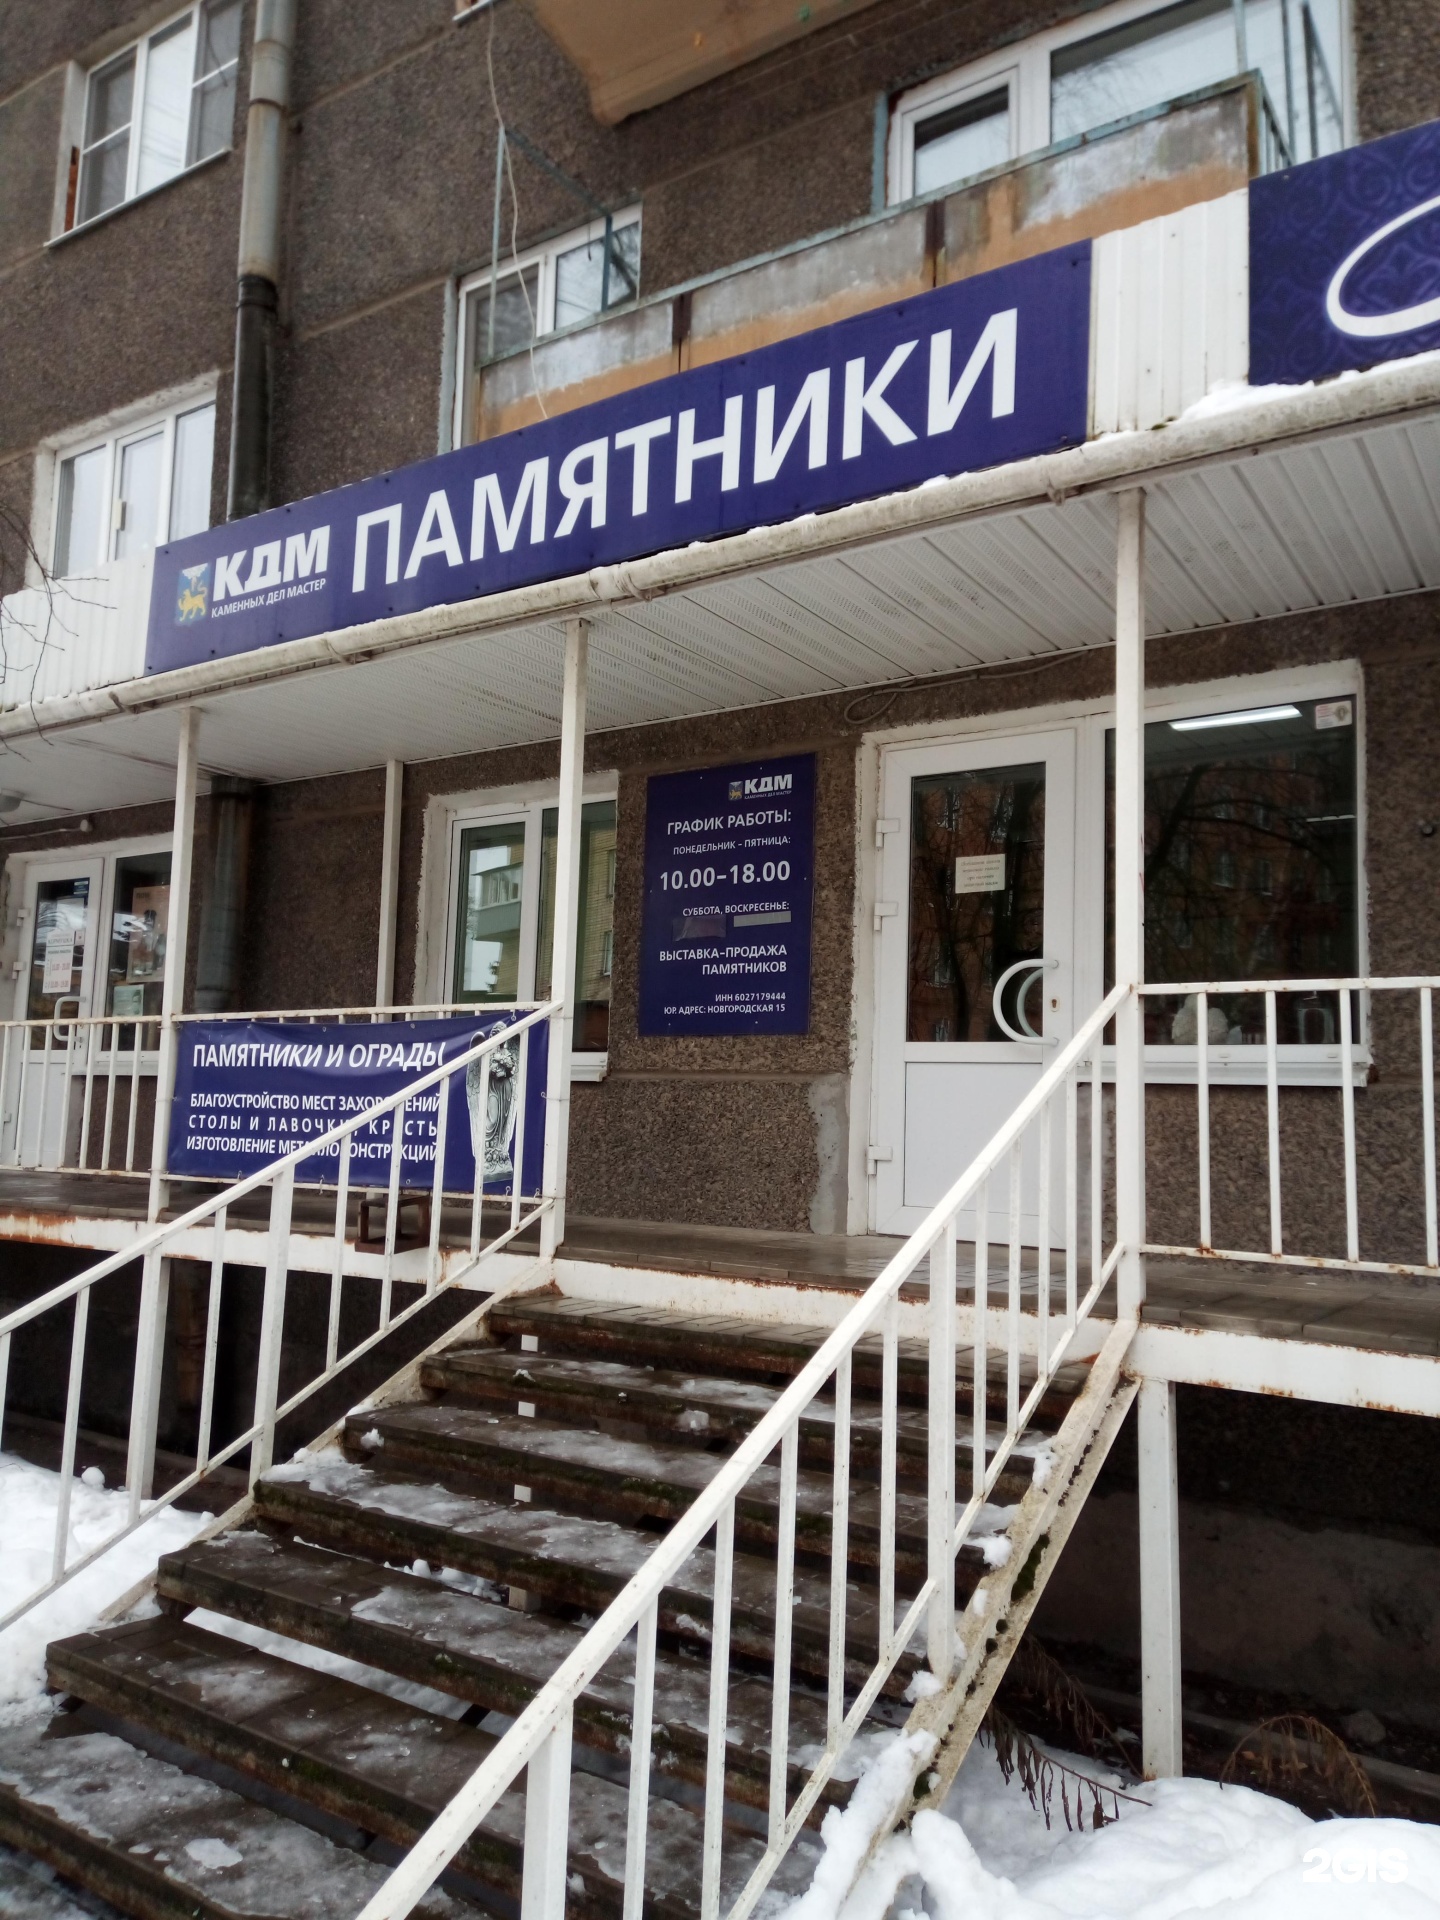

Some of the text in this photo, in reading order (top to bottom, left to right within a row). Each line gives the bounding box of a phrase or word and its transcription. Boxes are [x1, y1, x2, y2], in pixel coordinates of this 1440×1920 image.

[351, 308, 1018, 592] ПАМЯТНИКИ
[213, 525, 330, 601] КДМ
[211, 578, 326, 618] КАМЕННЫХ ДЕЛ МАСТЕР
[745, 774, 792, 794] КДМ
[667, 809, 791, 836] ГРАФИК РАБОТЫ:
[673, 841, 736, 855] ПОНЕДЕЛЬНИК
[744, 835, 791, 848] ПЯТНИЦА:
[660, 860, 791, 891] 10.00-18.00
[682, 901, 789, 917] СУББОТА, ВОСКРЕСЕНЬЕ:
[659, 944, 787, 961] ВЫСТАВКА-ПРОДАЖА
[702, 961, 787, 975] ПАМЯТНИКОВ
[715, 992, 786, 1002] ИНН 6027179444
[664, 1003, 785, 1015] ЮР. АДРЕС: НОВГОРОДСКАЯ 15
[193, 1042, 446, 1071] ПАМЯТНИКИ И ОГРАДЫ
[190, 1091, 300, 1109] БЛАГОУСТРОЙСТВО
[302, 1095, 336, 1111] МЕСТ
[188, 1114, 241, 1130] СТОЛЫ
[250, 1116, 259, 1131] И
[186, 1136, 276, 1154] ИЗГОТОВЛЕНИЕ
